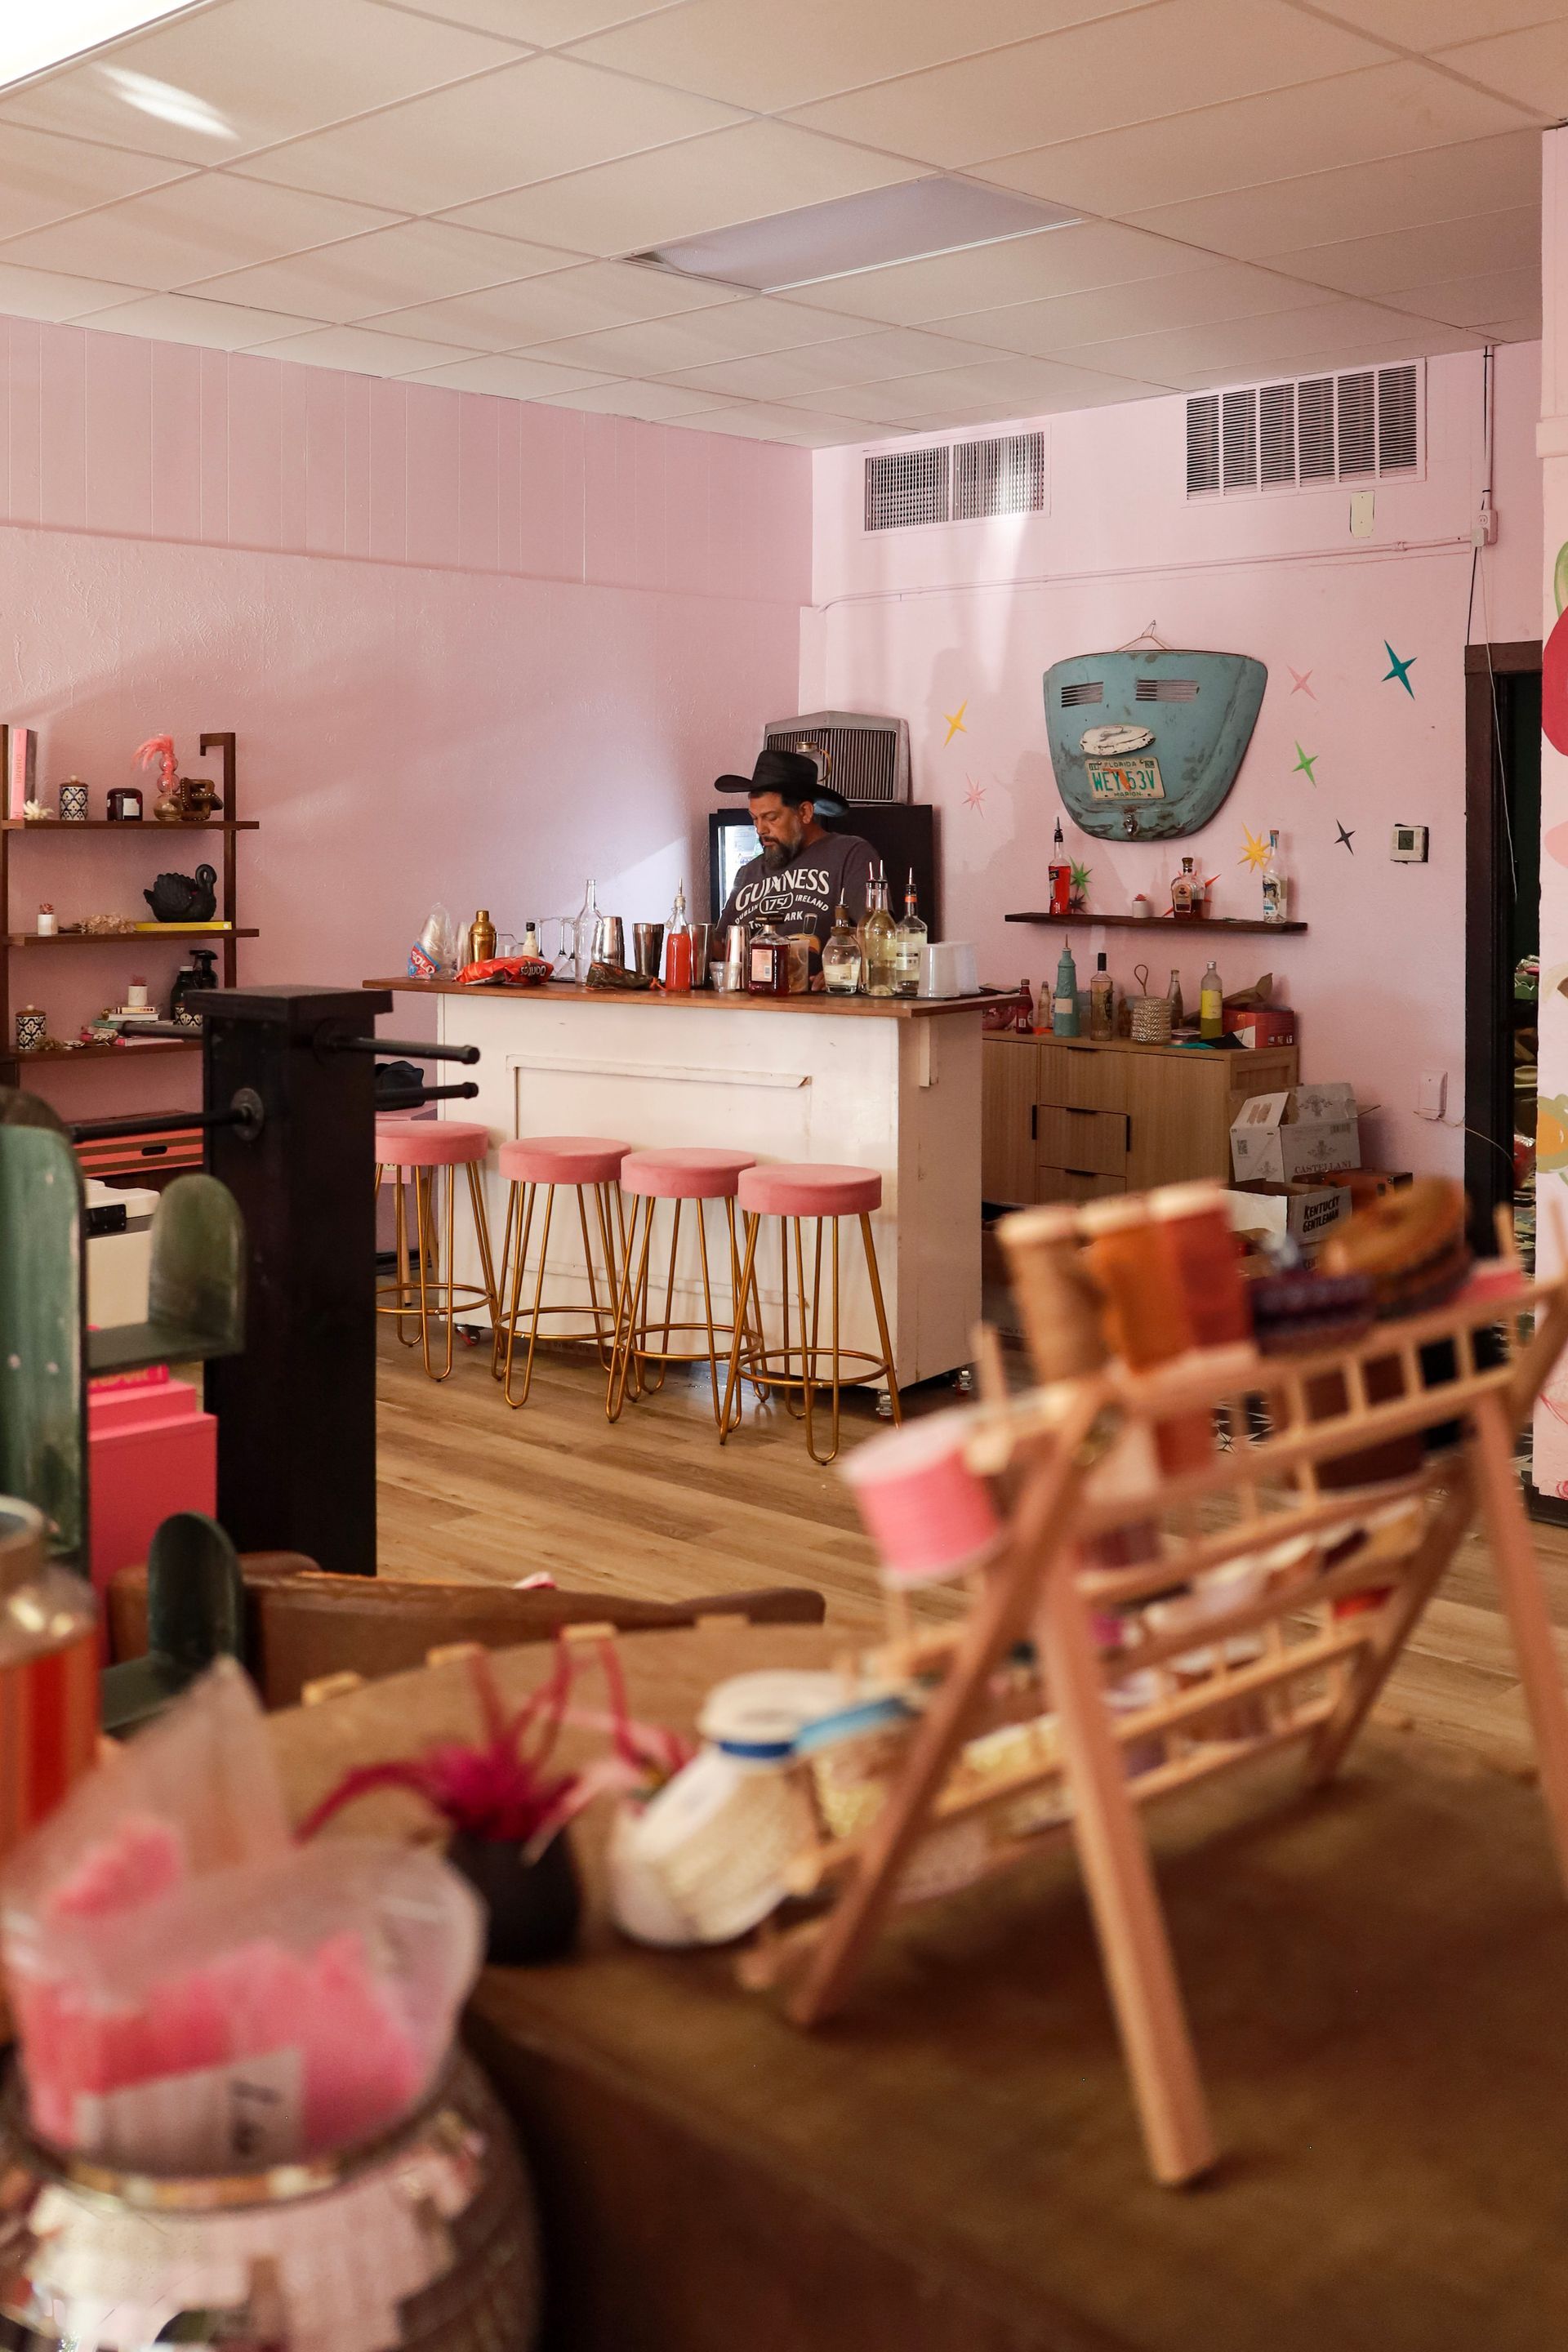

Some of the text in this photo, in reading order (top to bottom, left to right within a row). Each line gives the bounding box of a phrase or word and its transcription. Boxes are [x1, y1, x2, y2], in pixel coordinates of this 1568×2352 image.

[735, 868, 830, 911] GUINNESS
[735, 903, 760, 924] DUBLIN
[795, 894, 830, 911] IRELAND
[412, 950, 435, 974] SOLO
[1294, 1160, 1352, 1174] CASTELLANI
[1303, 1196, 1340, 1220] KENTUCKY
[1303, 1208, 1339, 1233] GENTLEMAN
